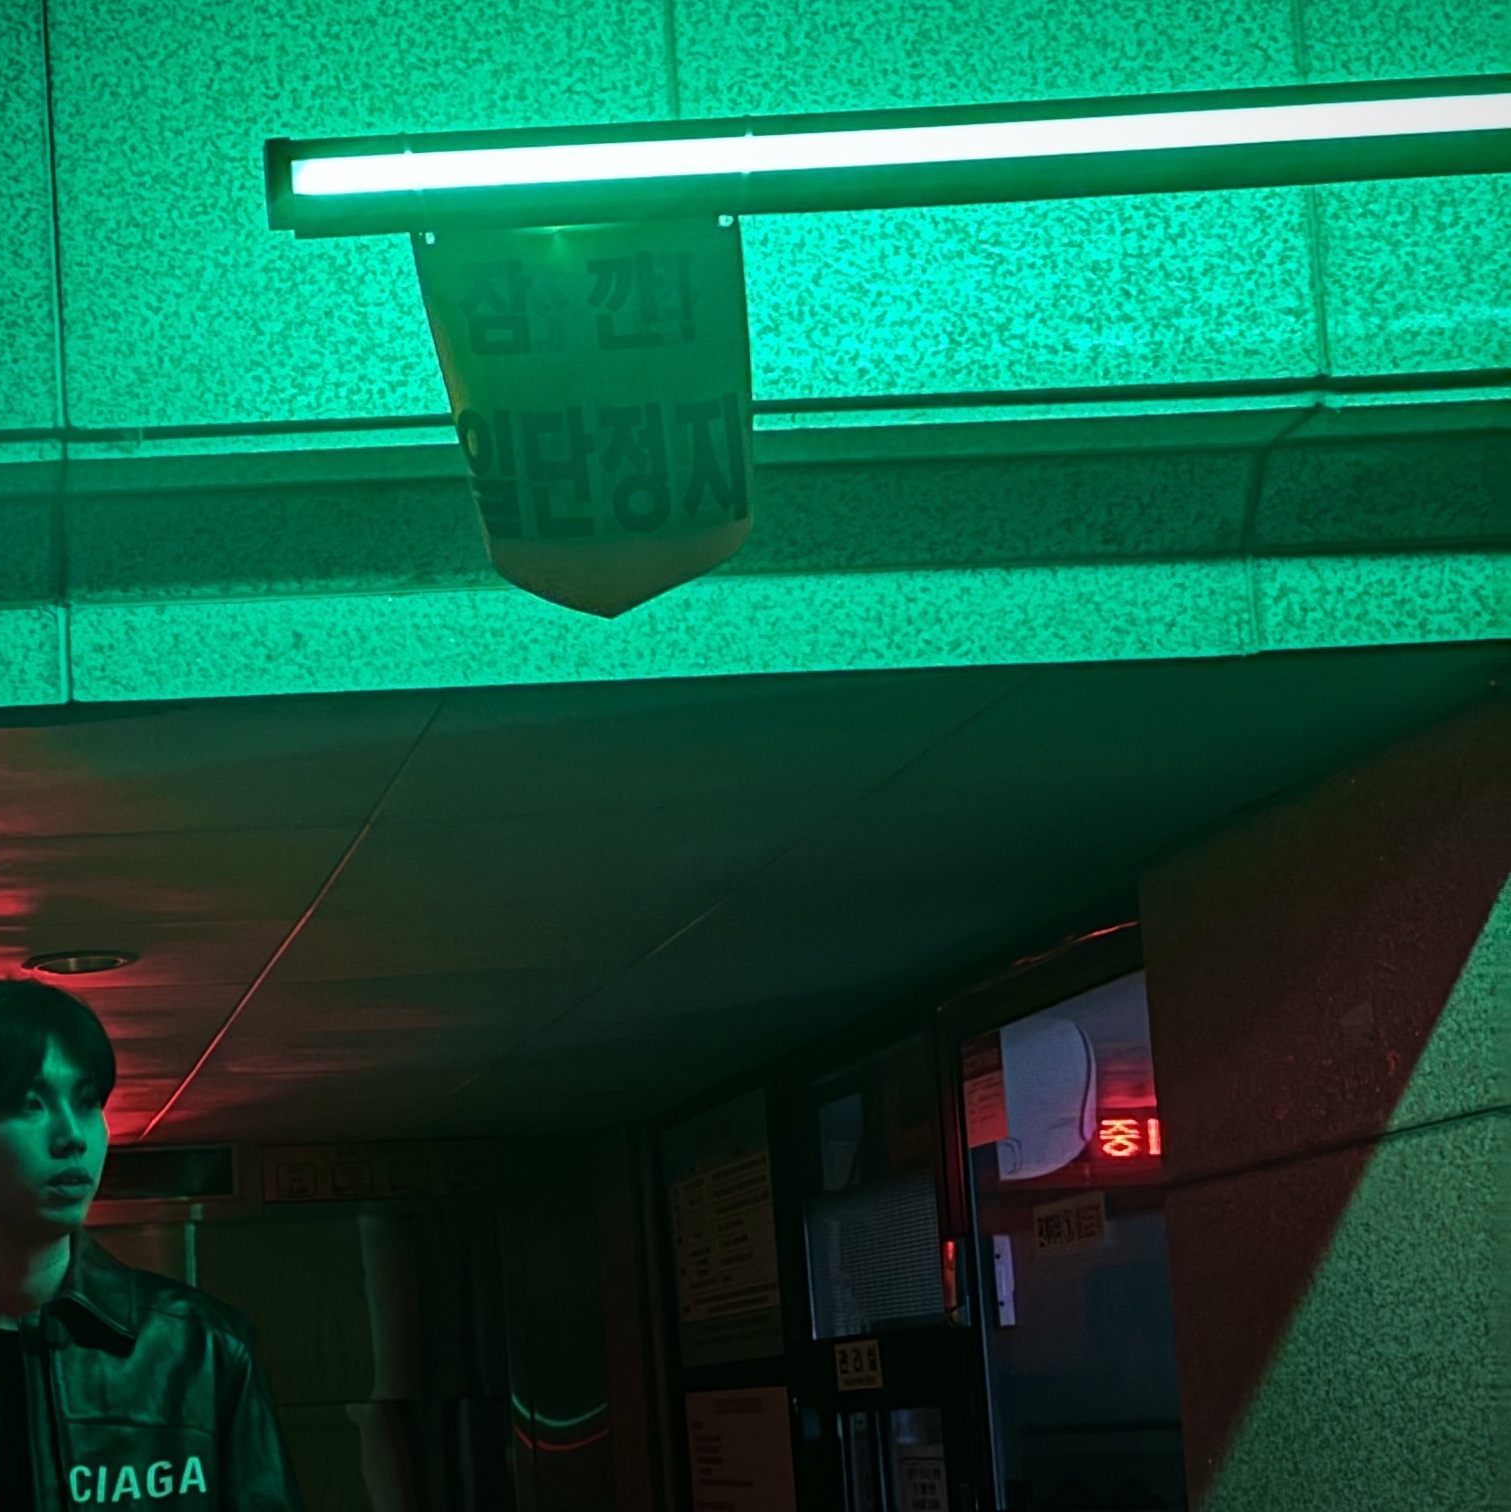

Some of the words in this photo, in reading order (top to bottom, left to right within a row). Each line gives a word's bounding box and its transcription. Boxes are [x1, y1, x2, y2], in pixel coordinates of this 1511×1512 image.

[457, 393, 748, 538] 일단정지
[1099, 1118, 1162, 1157] 중
[69, 1456, 207, 1503] CIAGA
